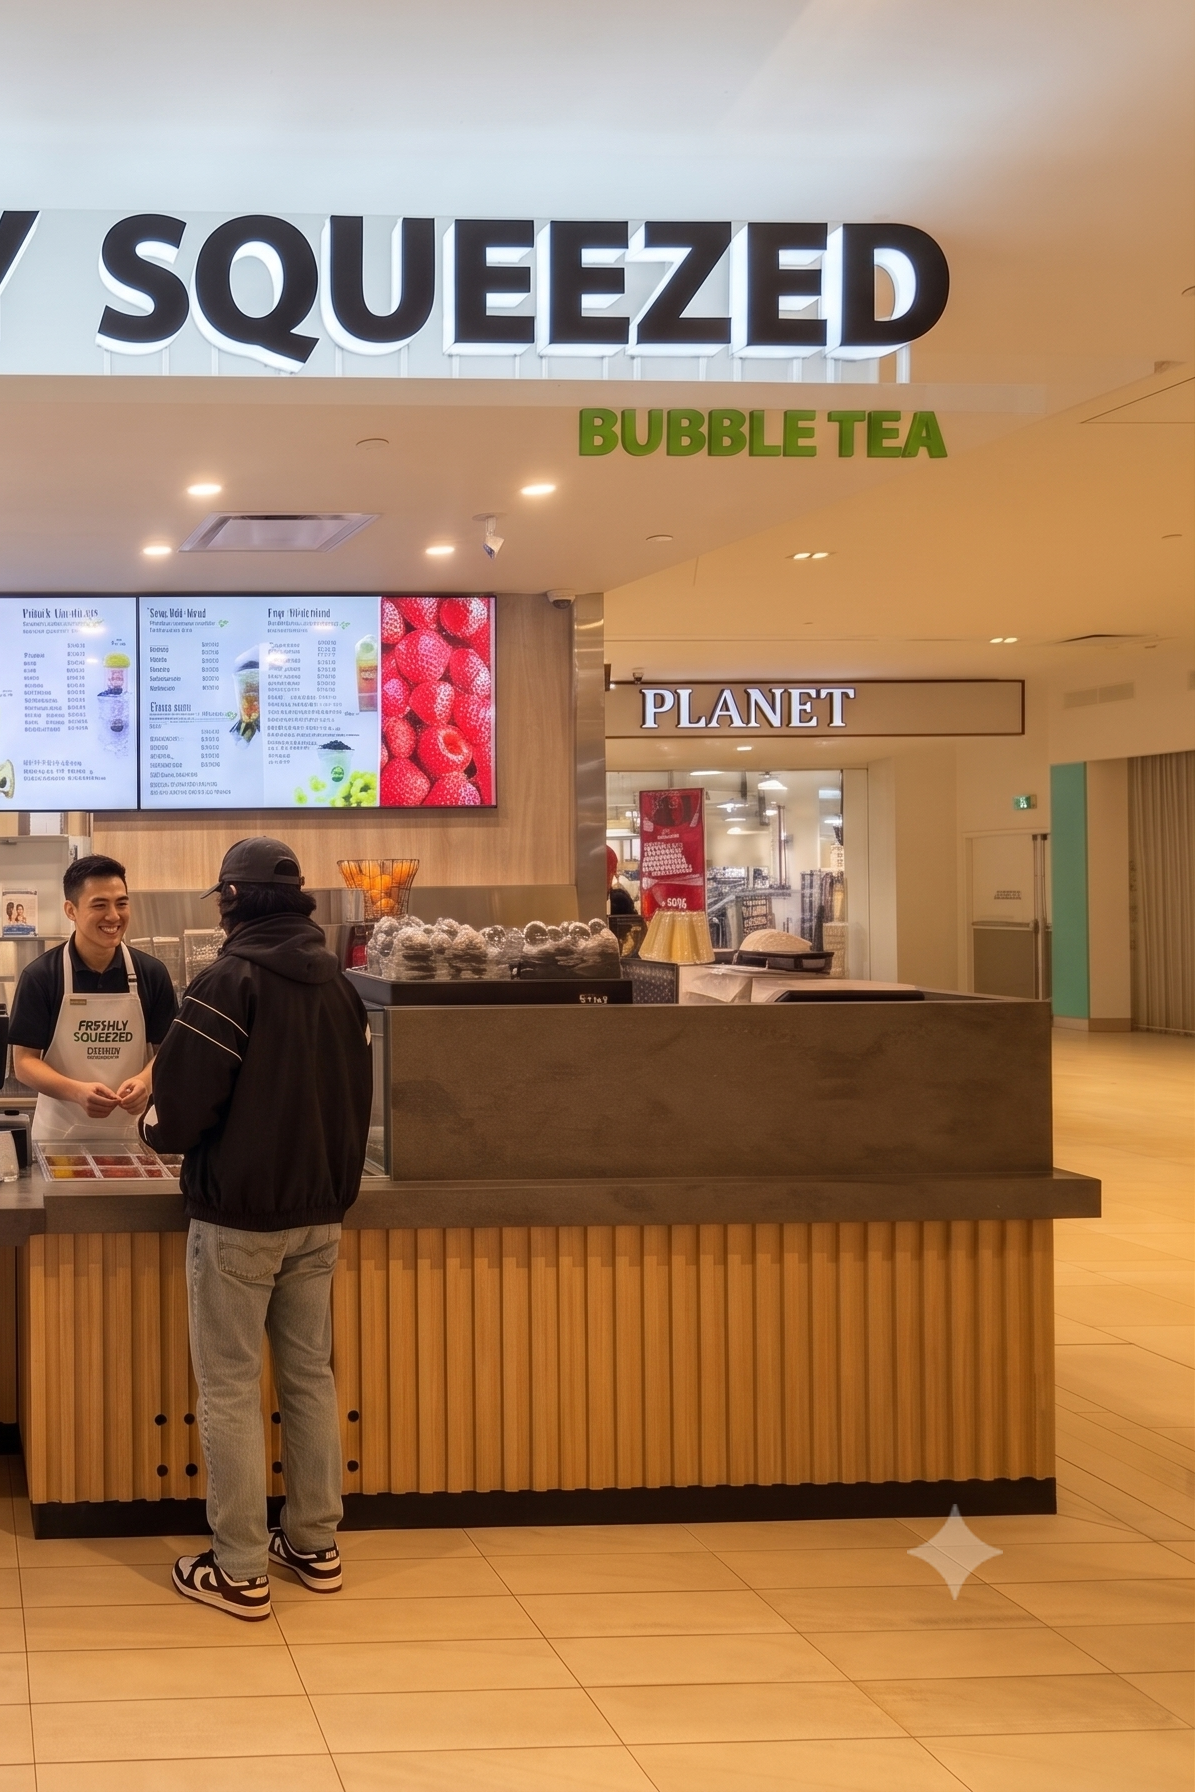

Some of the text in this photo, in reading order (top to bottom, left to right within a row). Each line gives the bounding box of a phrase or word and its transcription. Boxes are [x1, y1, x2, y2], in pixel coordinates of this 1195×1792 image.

[97, 213, 951, 364] SQUEEZED
[578, 407, 949, 459] BUBBLE TEA
[639, 686, 856, 729] PLANET
